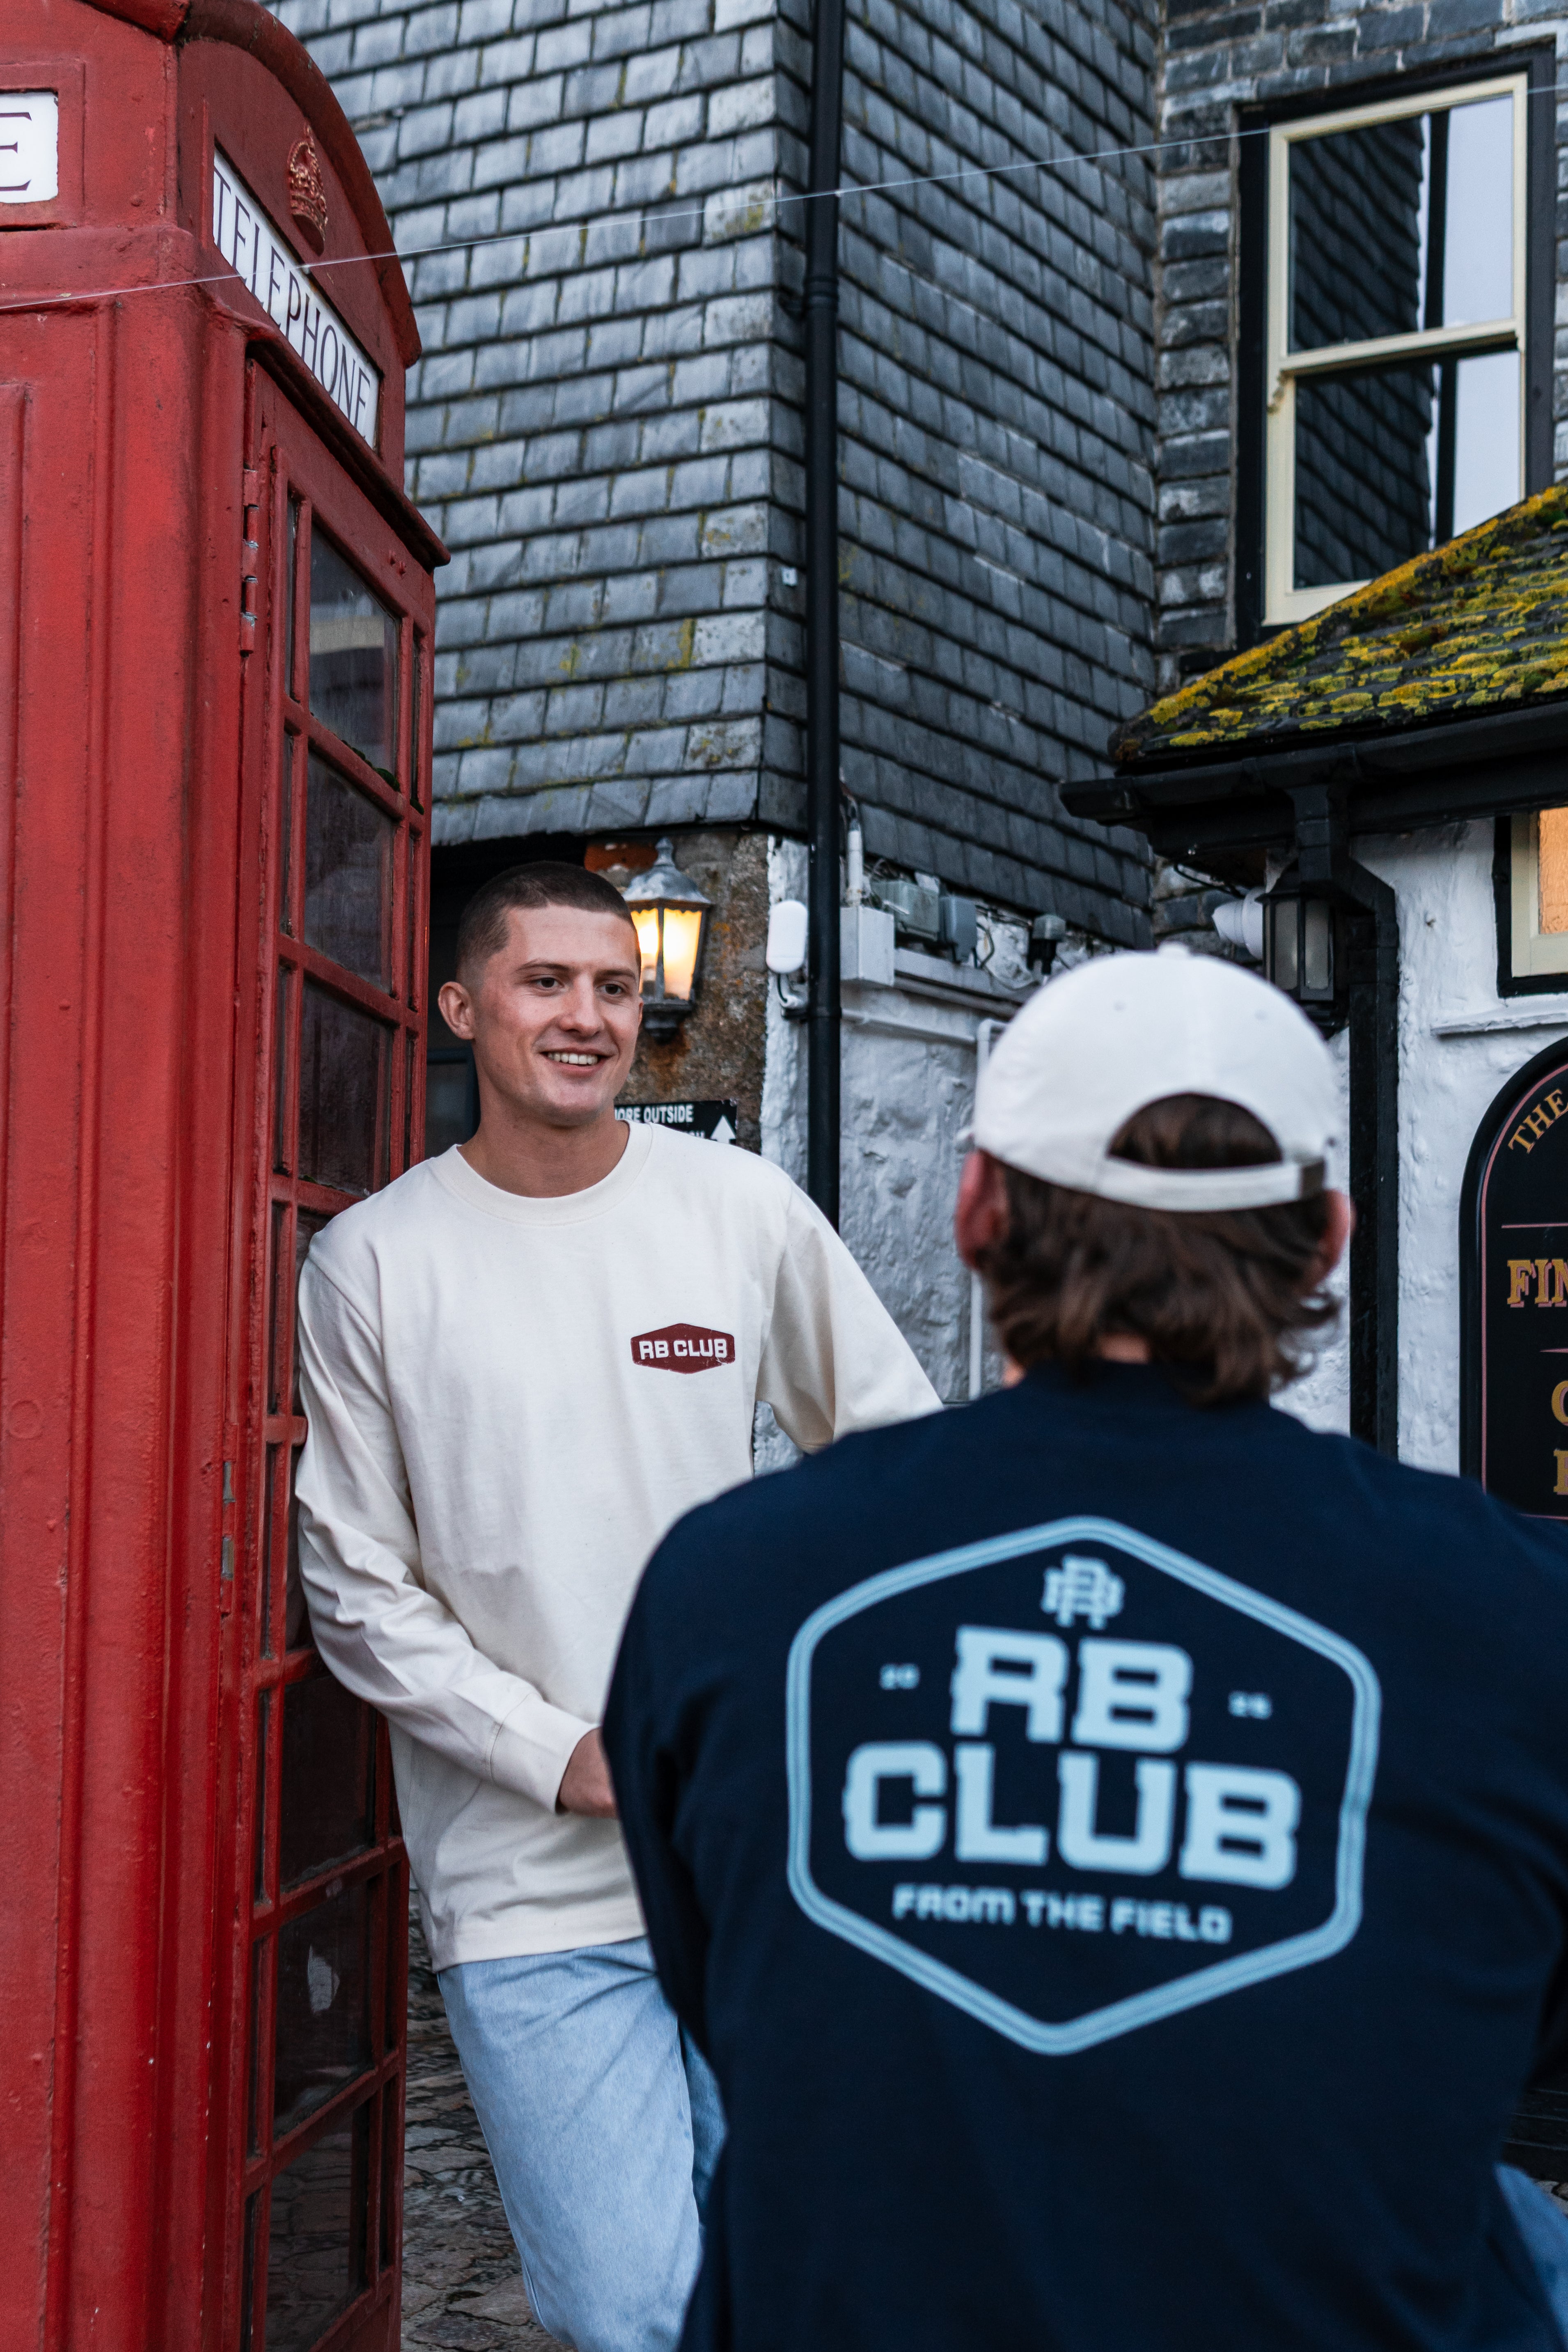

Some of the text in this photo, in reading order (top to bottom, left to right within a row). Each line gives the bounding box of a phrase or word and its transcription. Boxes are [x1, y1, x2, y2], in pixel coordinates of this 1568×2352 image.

[214, 166, 370, 439] TELEPHONE
[643, 1105, 693, 1123] OUTSIDE
[1508, 1089, 1568, 1154] THE
[639, 1339, 727, 1359] RB CLUB
[951, 1625, 1192, 1753] RB
[843, 1741, 1301, 1889] CLUB
[1021, 1891, 1104, 1932] THE
[1111, 1898, 1231, 1943] FIELD
